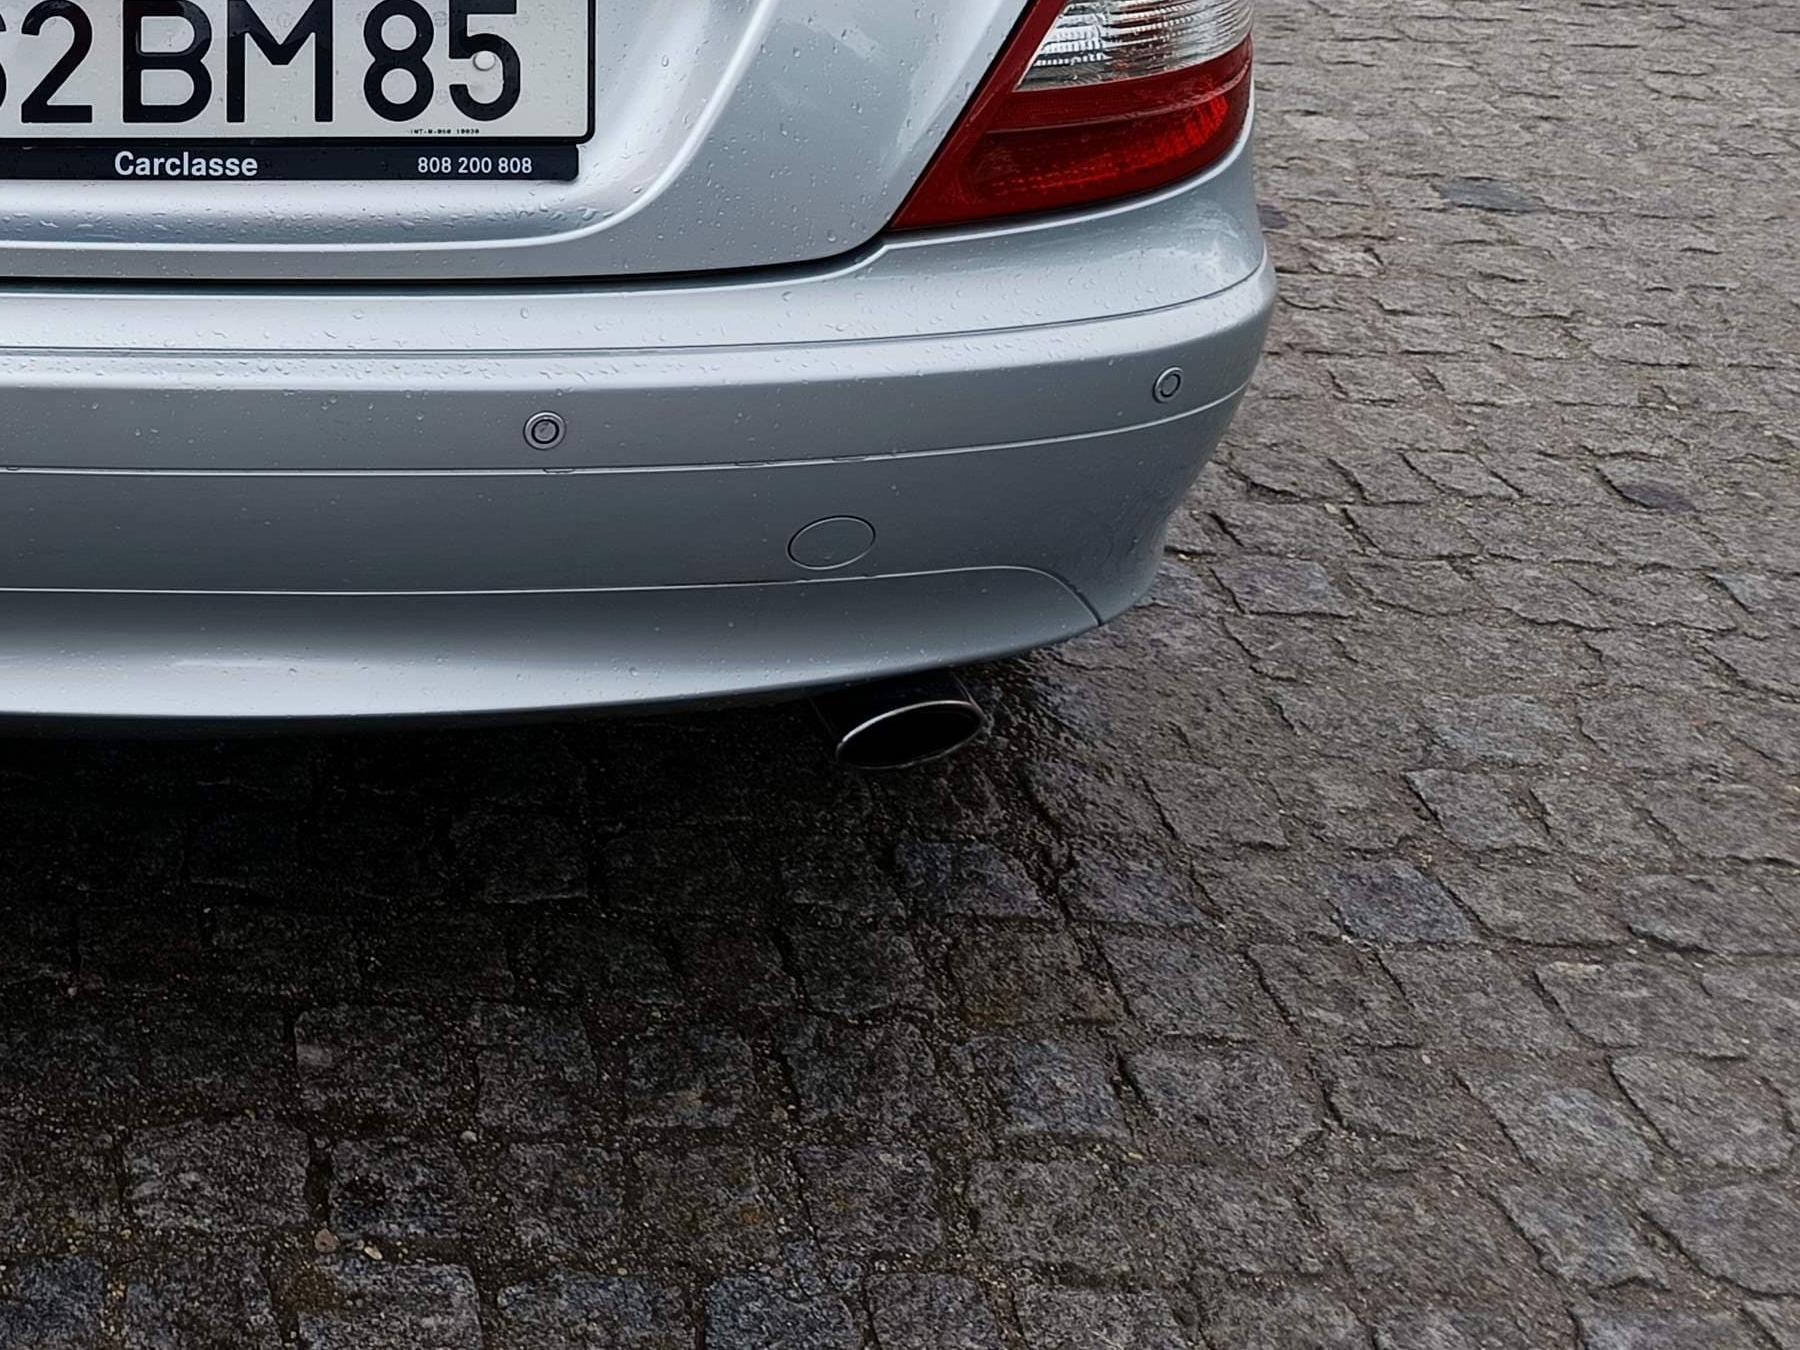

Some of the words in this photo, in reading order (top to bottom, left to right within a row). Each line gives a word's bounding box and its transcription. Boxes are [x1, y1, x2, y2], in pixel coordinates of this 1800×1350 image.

[114, 150, 258, 176] Carclasse
[417, 156, 452, 173] 808
[458, 156, 492, 173] 200
[498, 157, 533, 174] 808
